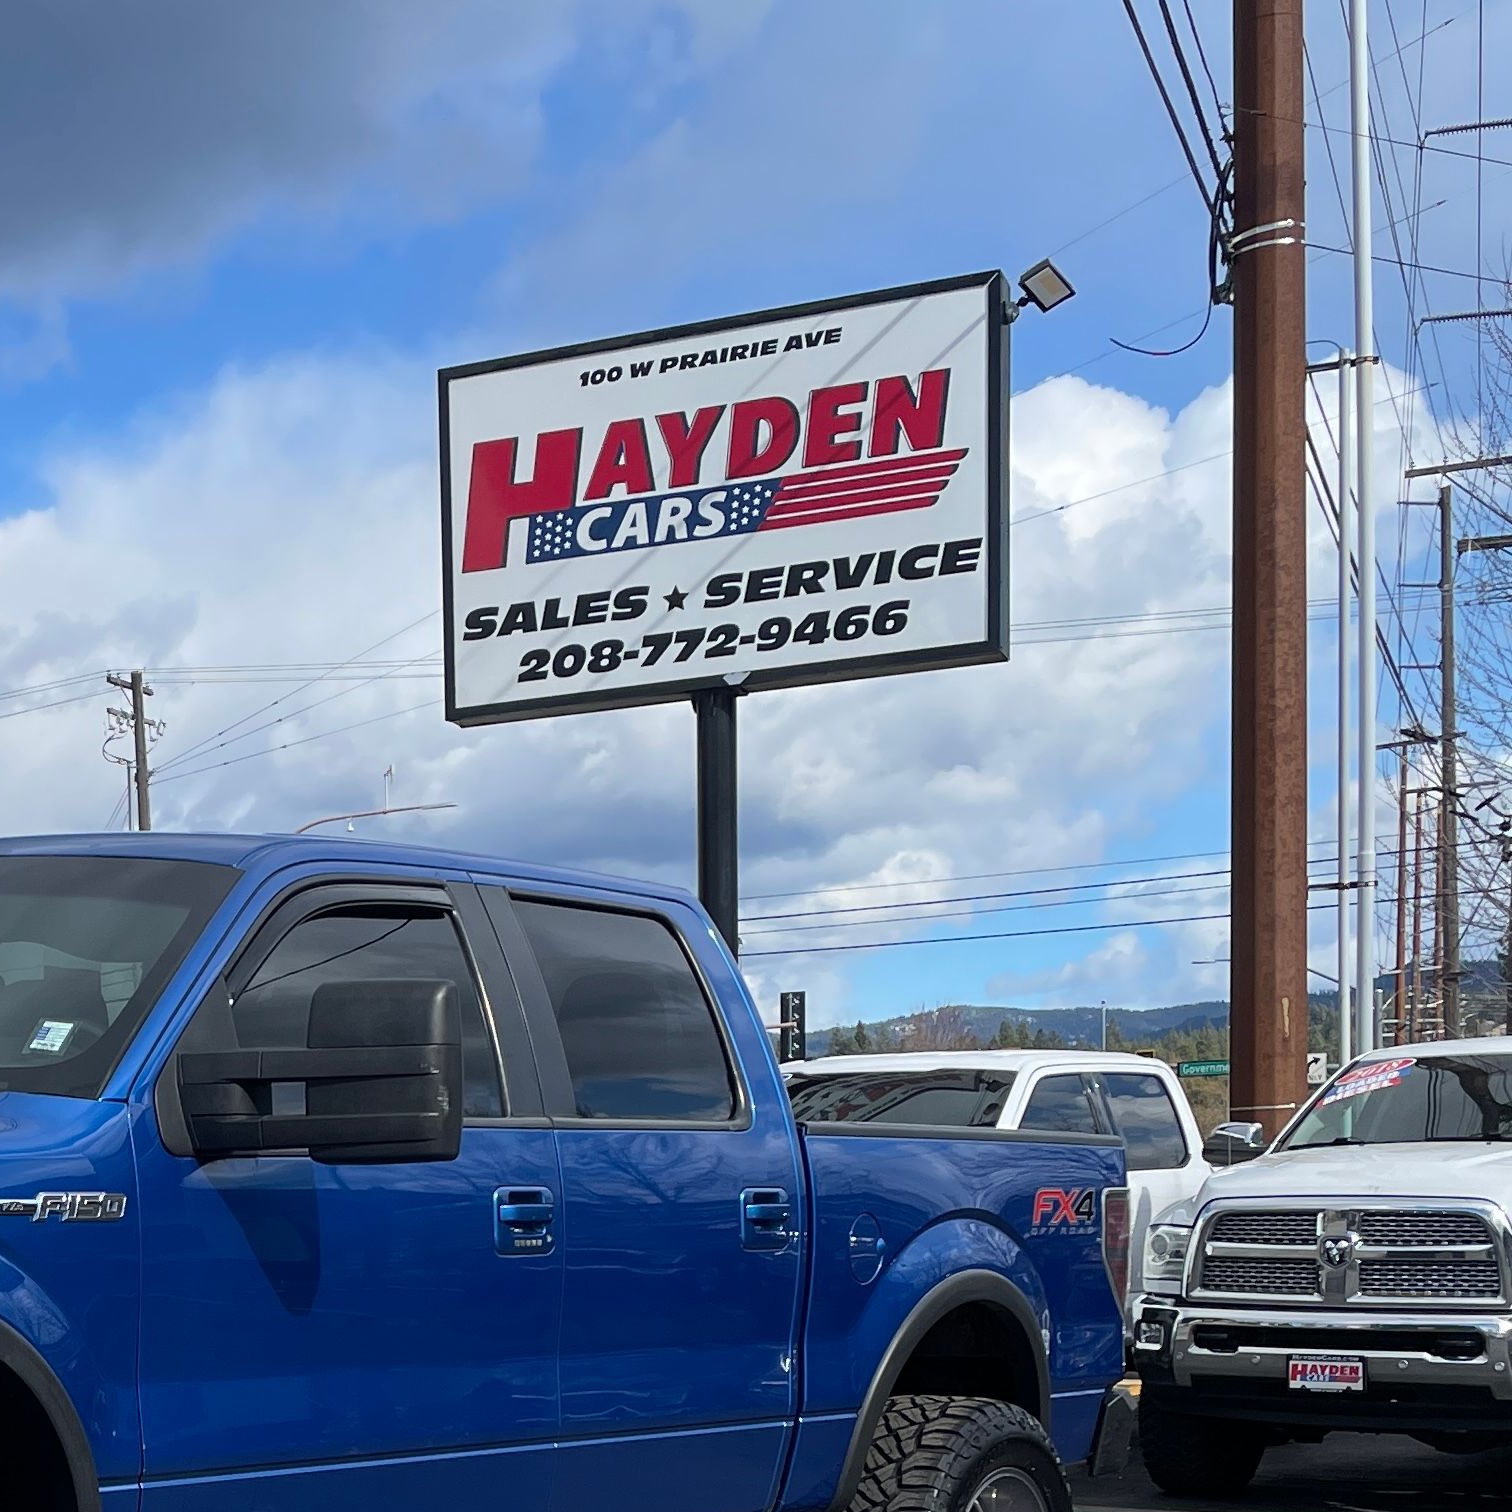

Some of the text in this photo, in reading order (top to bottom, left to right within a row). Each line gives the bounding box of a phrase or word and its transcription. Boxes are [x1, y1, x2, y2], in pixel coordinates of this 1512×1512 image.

[579, 326, 843, 387] 100 W PRAIRIE AVE
[462, 368, 951, 573] HAYDEN
[575, 489, 728, 553] CARS
[462, 537, 984, 642] SALES SERVICE
[517, 599, 911, 684] 208-772-9466
[1031, 1186, 1097, 1227] FX4
[1290, 1363, 1360, 1381] HAYDEN
